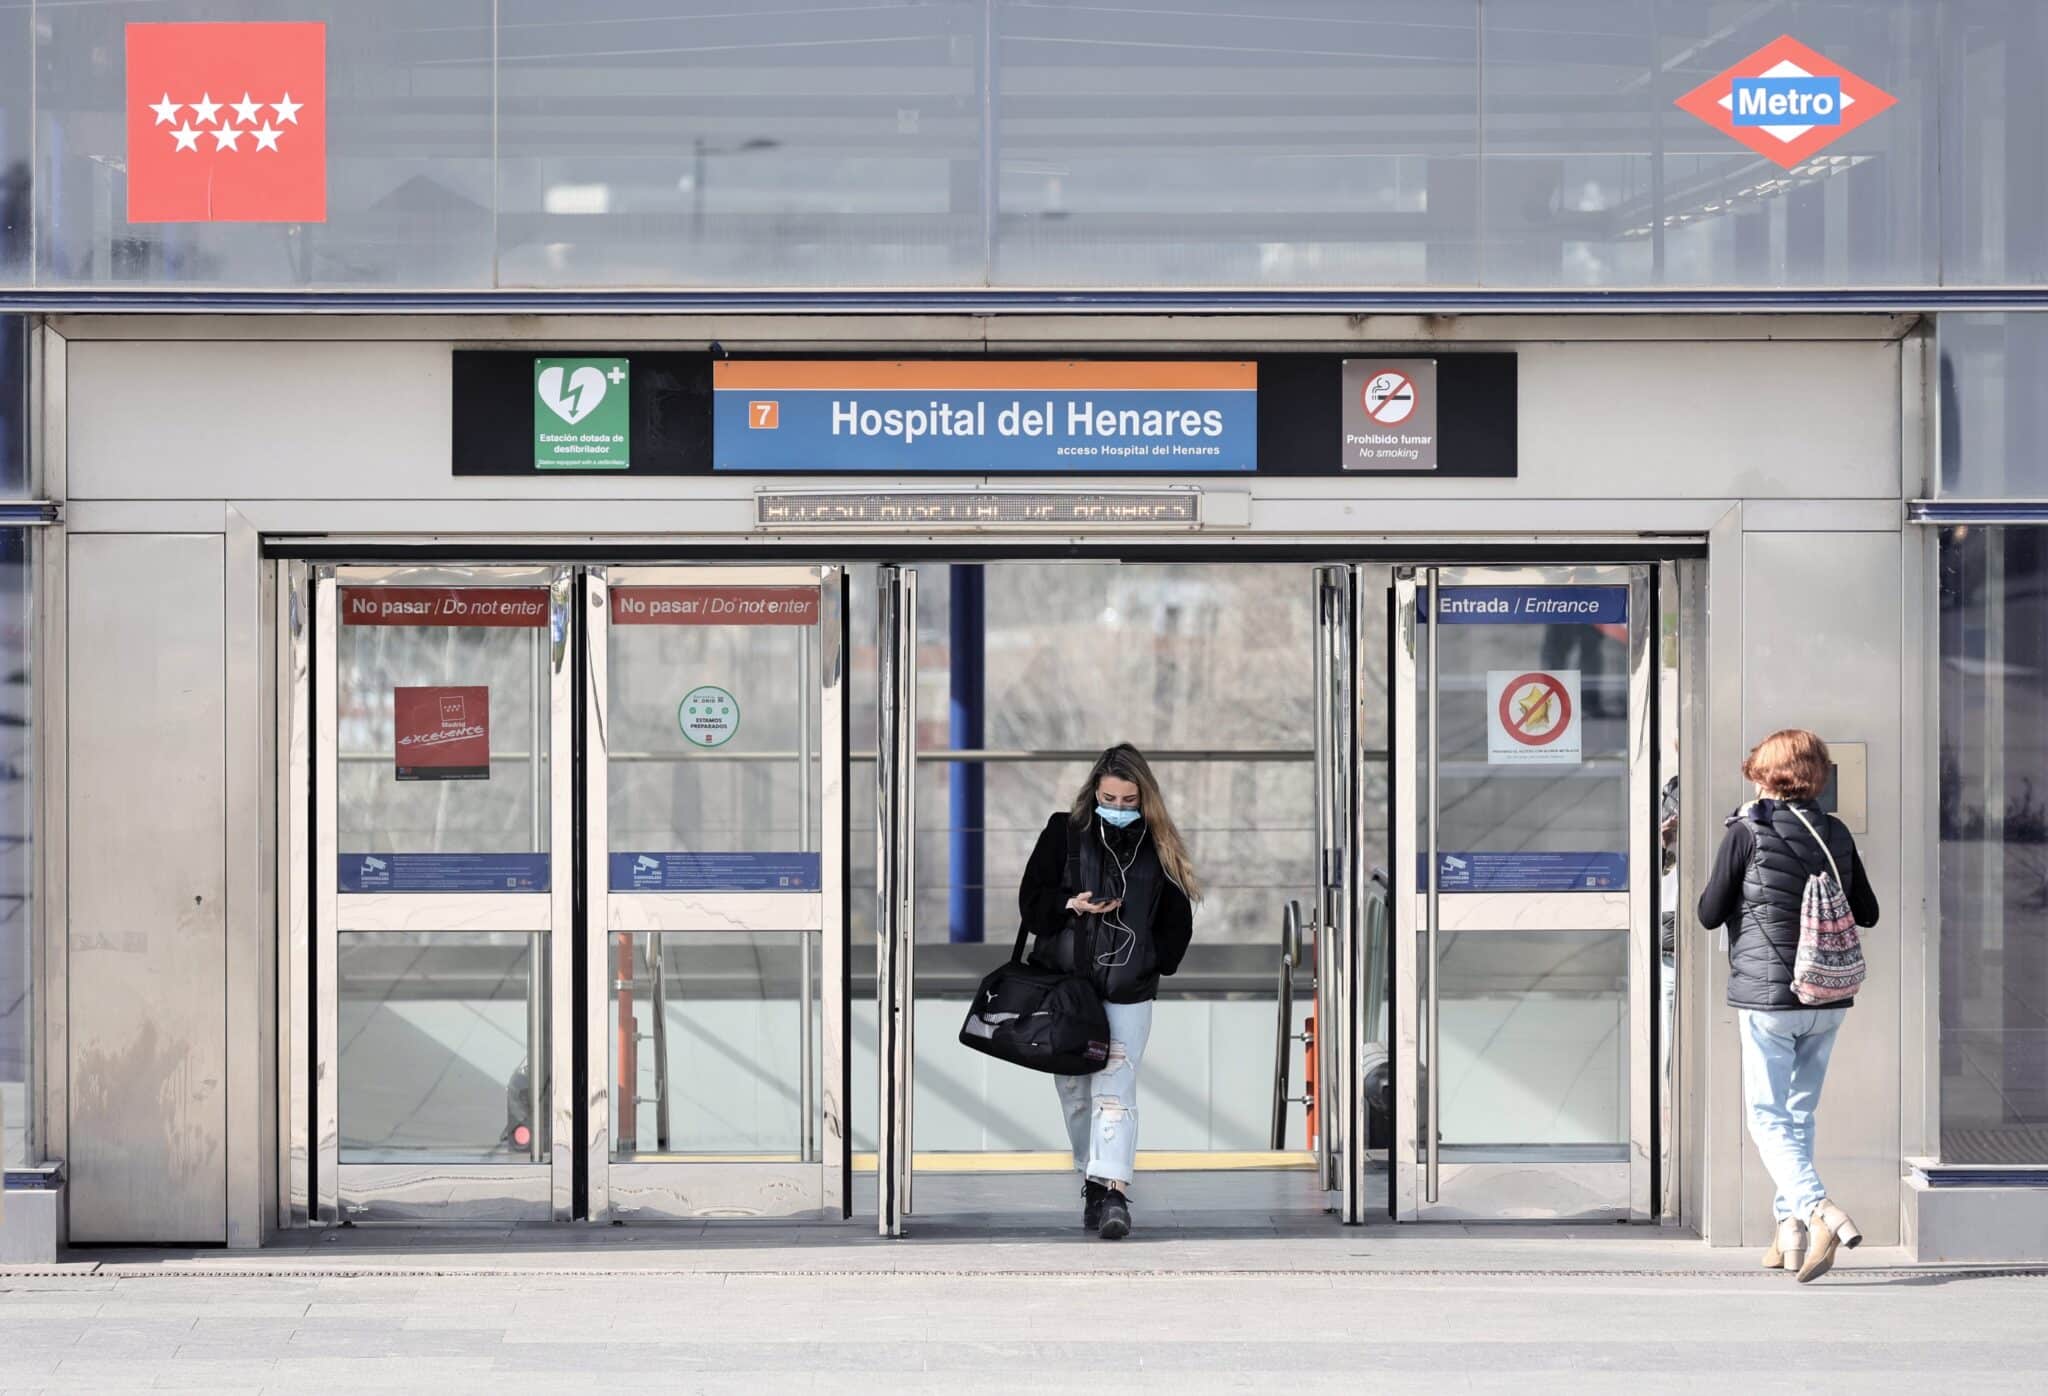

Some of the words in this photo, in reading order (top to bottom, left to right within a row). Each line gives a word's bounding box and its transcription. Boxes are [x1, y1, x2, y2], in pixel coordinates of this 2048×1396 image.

[1738, 87, 1834, 116] Metro
[755, 404, 772, 426] 7
[831, 400, 985, 444] Hospital
[997, 400, 1054, 437] del
[1067, 400, 1224, 437] Henares
[539, 433, 578, 443] Estación
[580, 433, 611, 443] dotada
[612, 434, 625, 443] de
[1346, 434, 1399, 445] Prohibido
[1400, 434, 1432, 445] fumar
[553, 444, 611, 454] desfibrilador
[1056, 446, 1098, 456] acceso
[1101, 445, 1149, 458] Hospital
[1152, 445, 1170, 456] del
[1172, 445, 1221, 456] Henares
[1359, 447, 1375, 458] No
[1376, 447, 1419, 460] smoking
[352, 598, 378, 614] No
[380, 600, 432, 618] pasar
[442, 599, 468, 615] Do
[470, 600, 498, 616] not
[499, 601, 545, 616] enter
[619, 597, 646, 614] No
[648, 600, 700, 617] pasar
[710, 598, 735, 614] Do
[737, 599, 766, 614] not
[767, 600, 813, 614] enter
[1439, 597, 1510, 613] Entrada
[1524, 597, 1600, 613] Entrance
